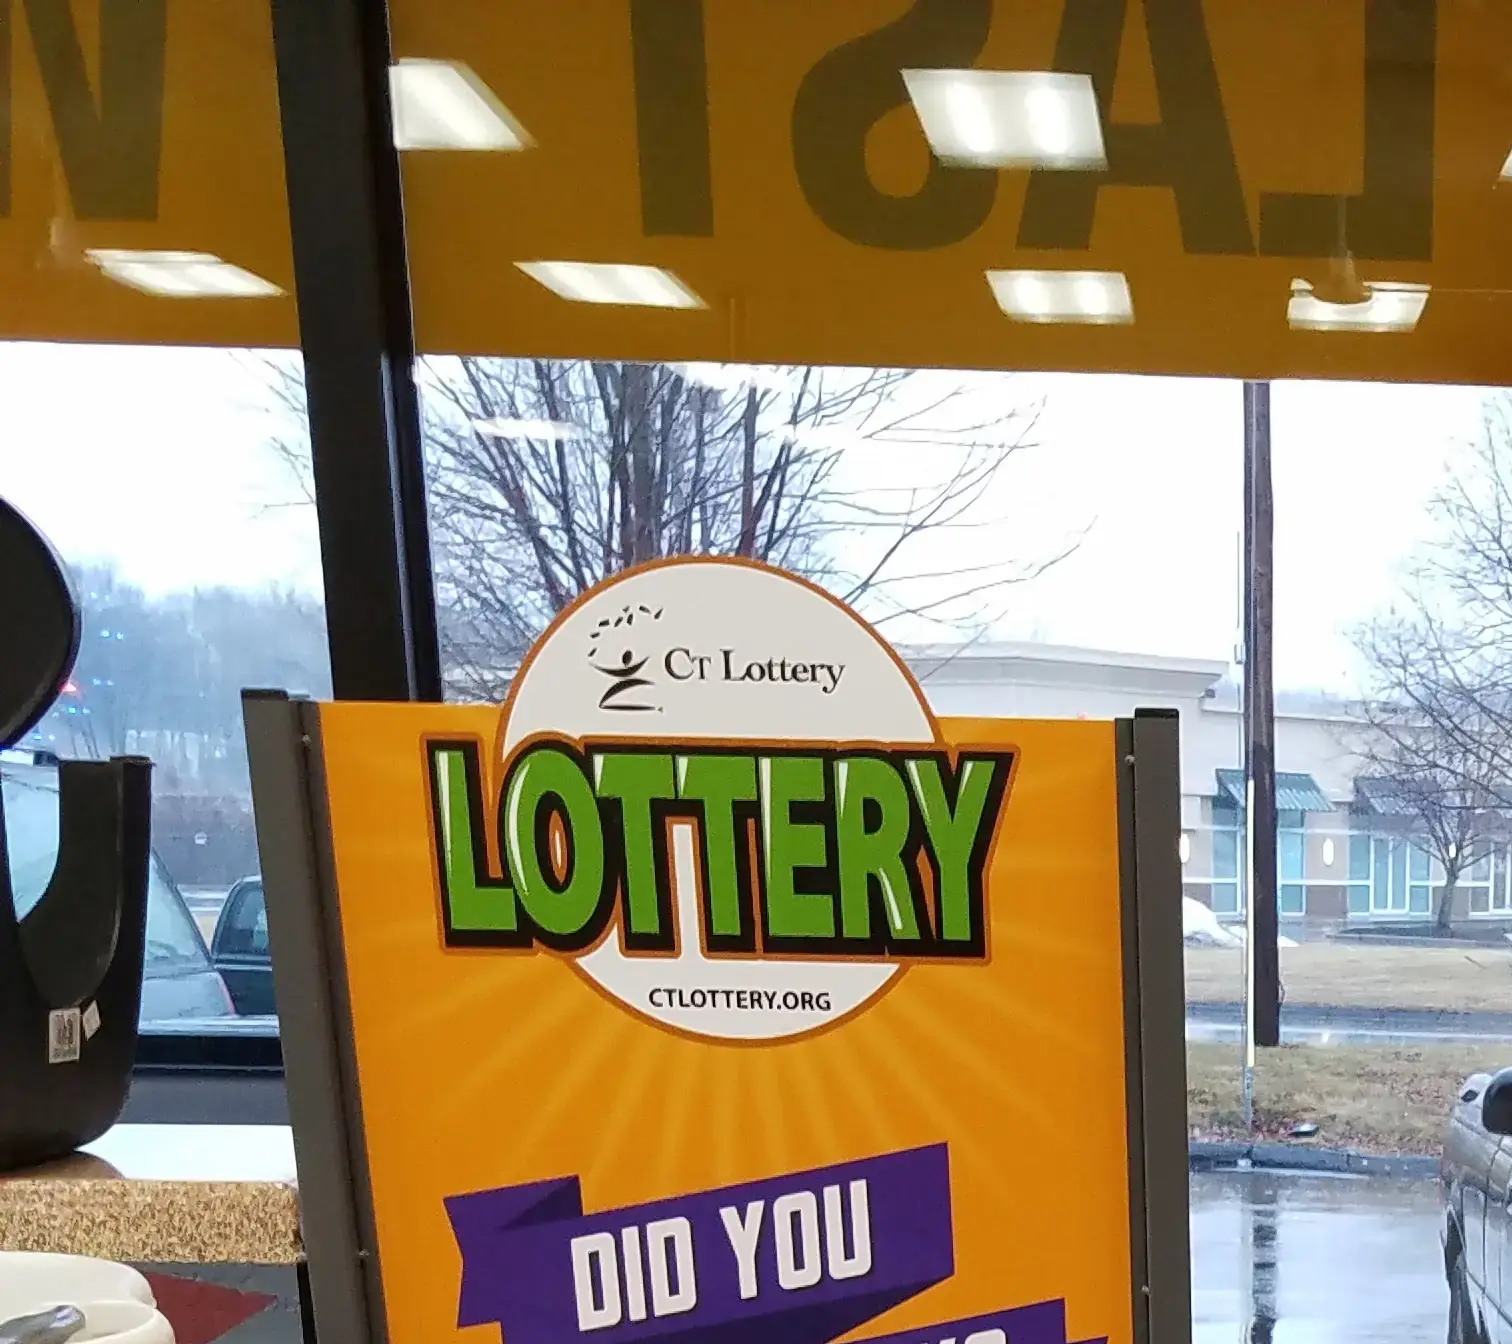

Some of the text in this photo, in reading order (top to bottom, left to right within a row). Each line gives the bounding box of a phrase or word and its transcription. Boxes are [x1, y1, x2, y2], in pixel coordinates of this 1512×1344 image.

[720, 649, 846, 692] Lottery
[428, 738, 1013, 958] LOTTERY
[648, 987, 832, 1011] CTLOTTERY.ORG
[571, 1179, 872, 1332] DID YOU
